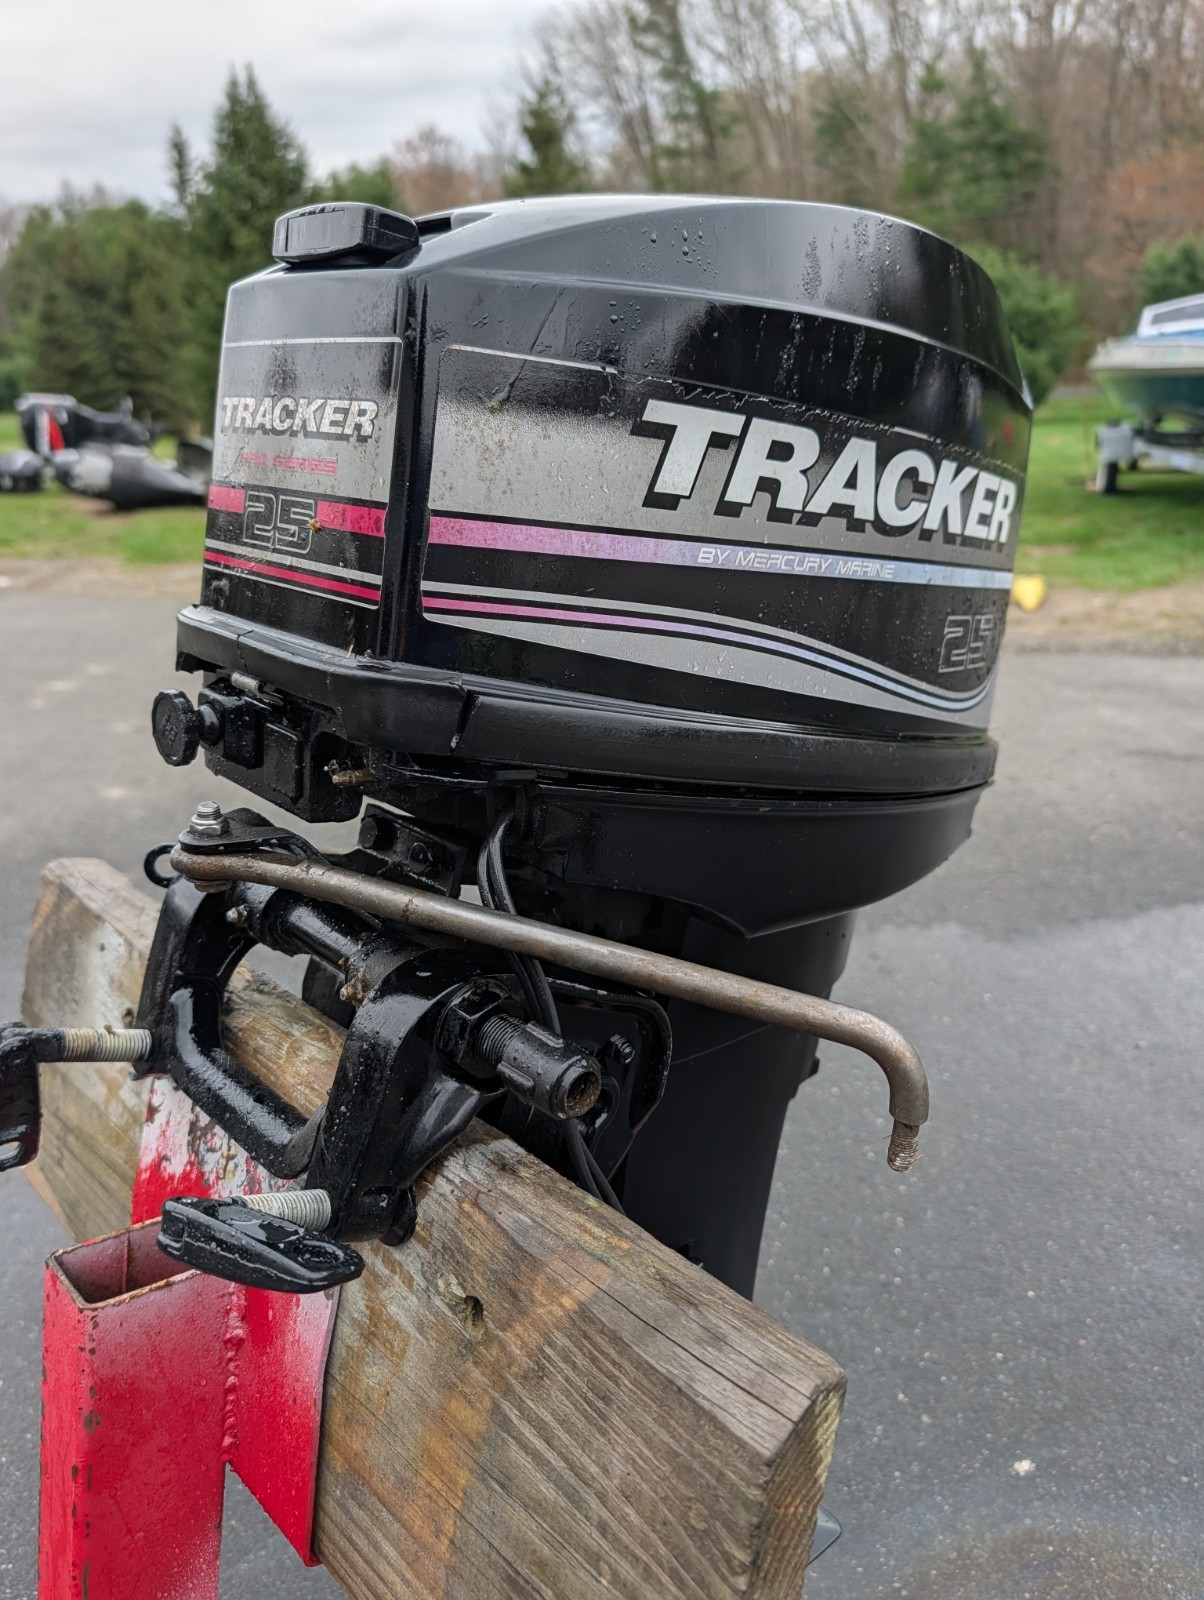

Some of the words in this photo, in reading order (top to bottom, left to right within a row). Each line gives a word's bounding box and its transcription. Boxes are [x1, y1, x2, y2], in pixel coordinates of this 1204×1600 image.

[222, 396, 379, 441] TRACKER
[638, 398, 1017, 546] TRACKER
[242, 488, 316, 555] 25
[697, 547, 730, 565] BY
[735, 551, 831, 573] MERCURY
[836, 560, 896, 579] MARINE
[938, 614, 994, 674] 25
